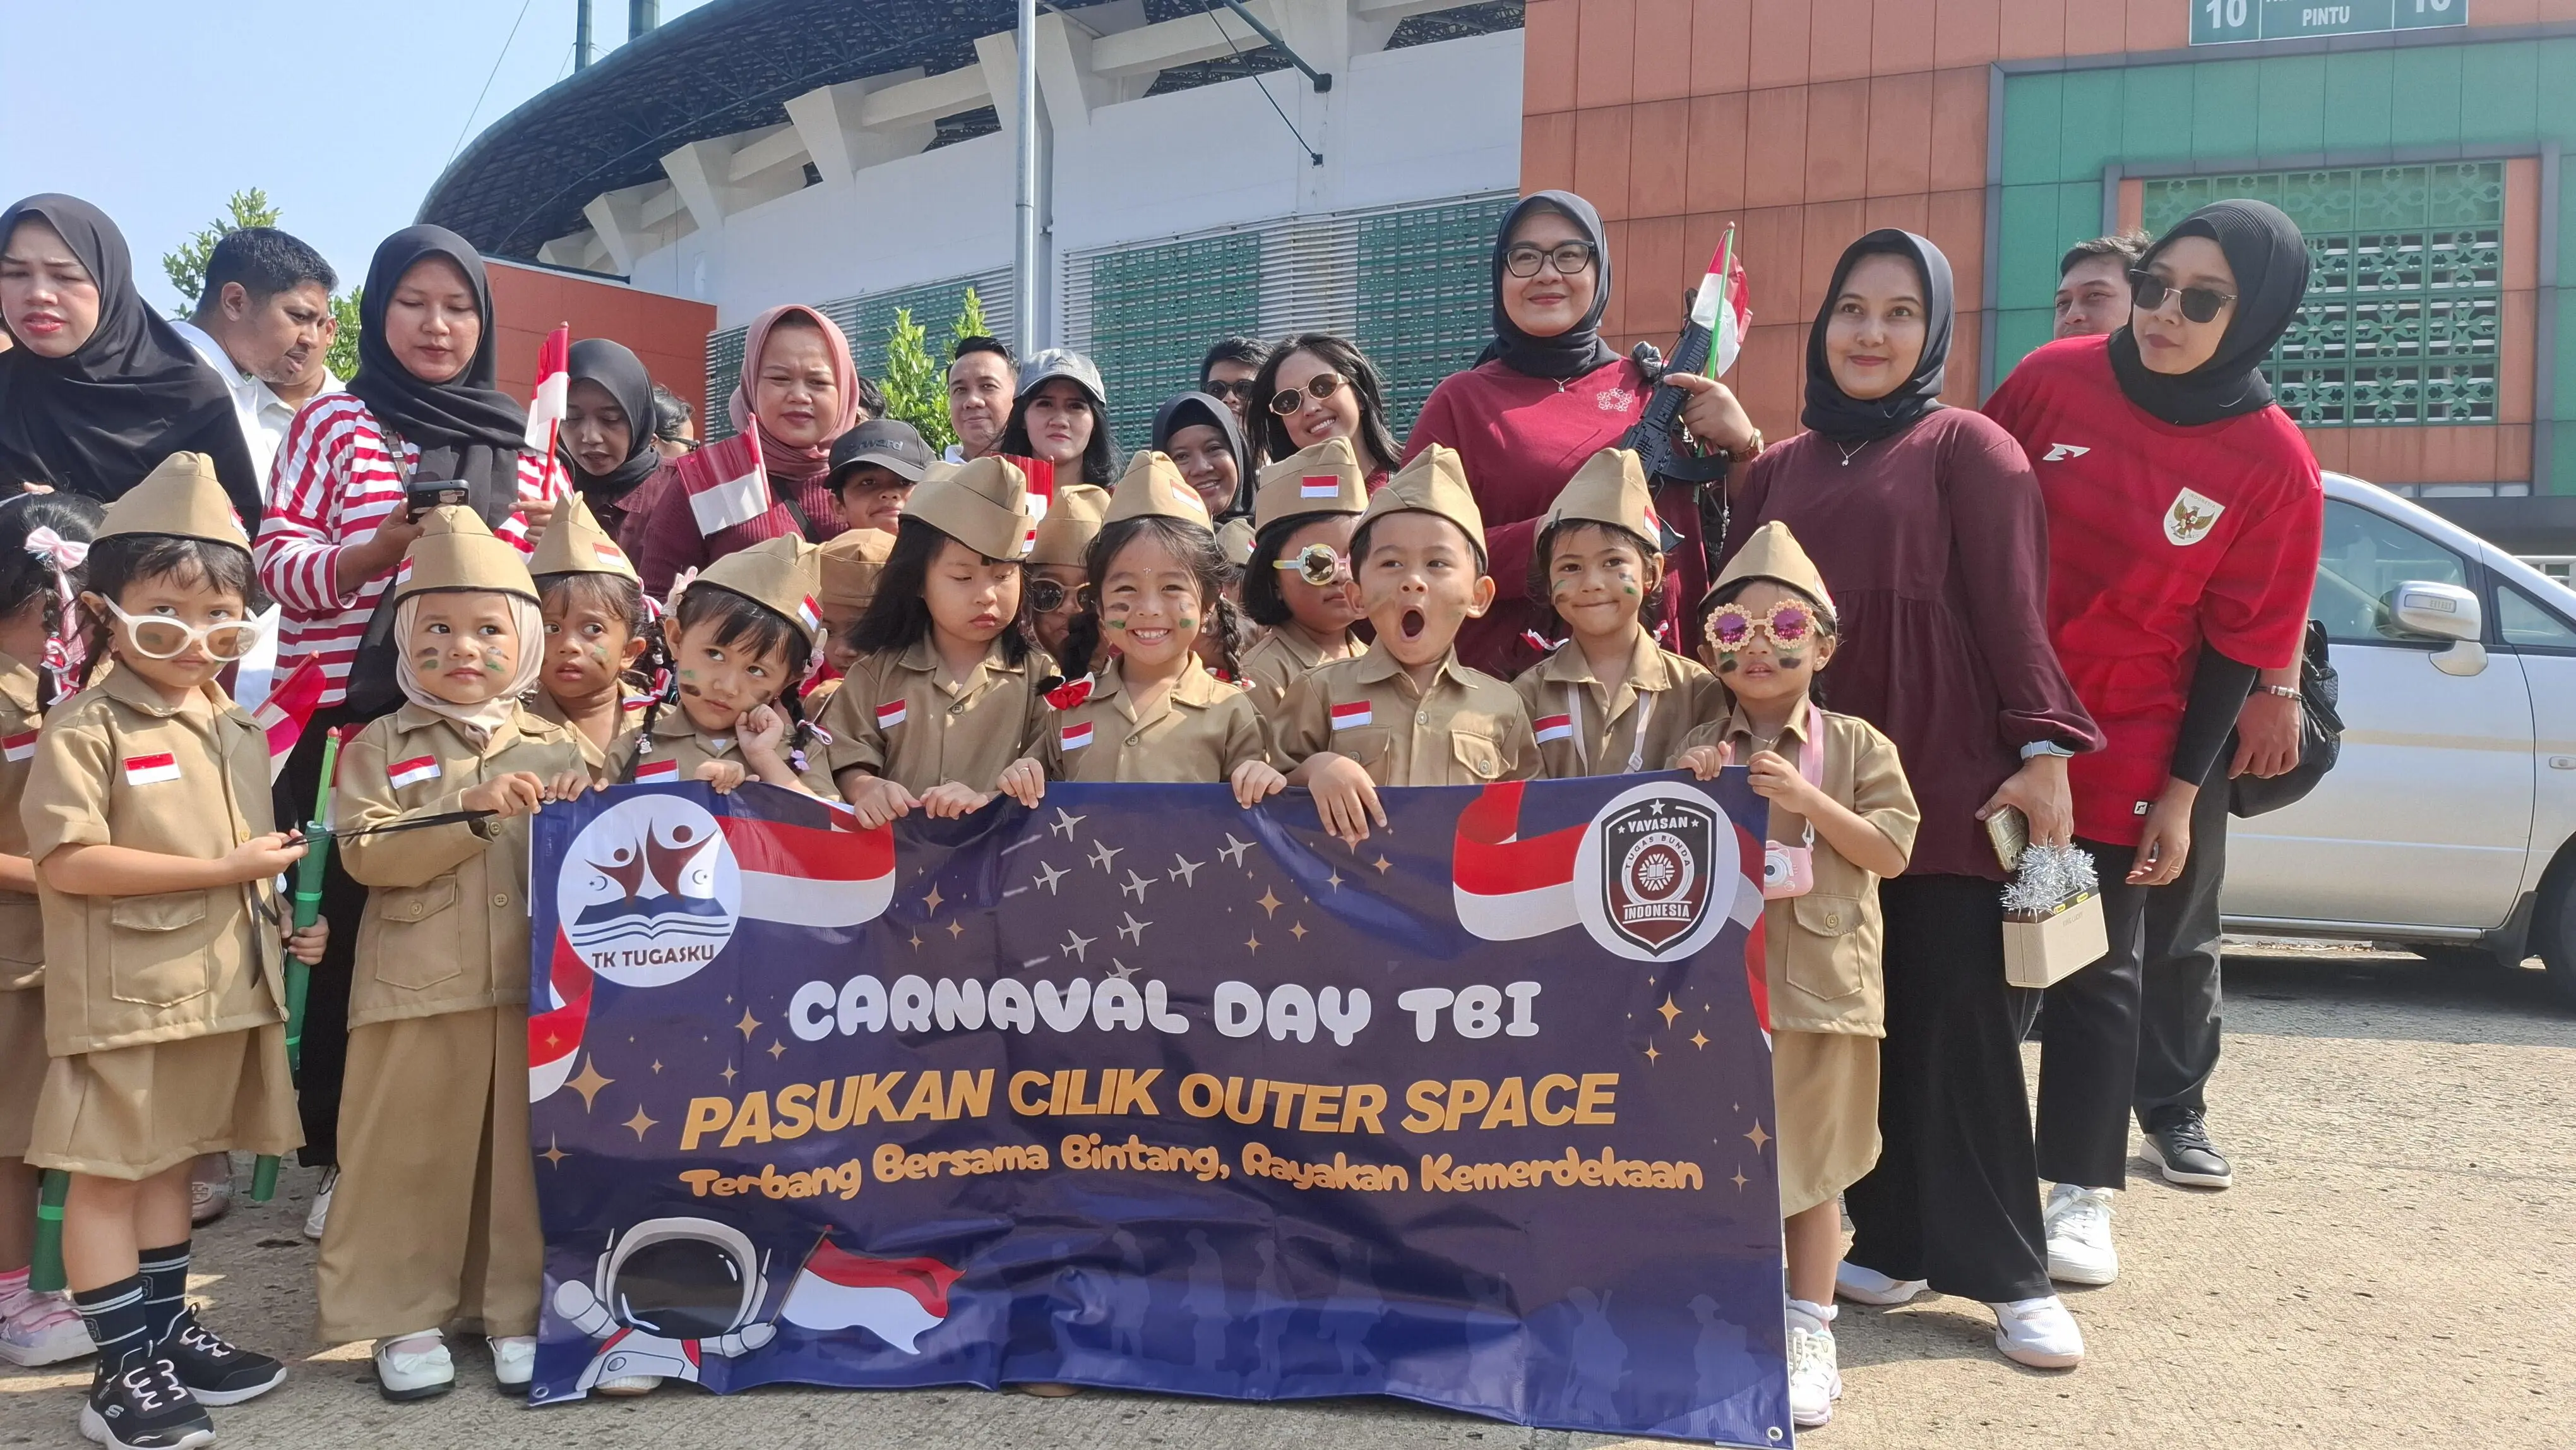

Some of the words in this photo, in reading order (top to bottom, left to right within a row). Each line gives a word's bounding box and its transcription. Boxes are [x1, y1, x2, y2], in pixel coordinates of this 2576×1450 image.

[2206, 0, 2247, 28] 10
[2302, 6, 2351, 27] PINTU
[1628, 816, 1688, 833] YAYASAN
[1625, 836, 1654, 870] TUGAS
[1661, 834, 1691, 866] BUNDA
[1625, 904, 1690, 920] INDONESIA
[592, 952, 616, 968] TK
[623, 944, 715, 966] TUGASKU
[789, 974, 1189, 1041] CARNAVAL
[1214, 981, 1371, 1046] DAY
[1398, 981, 1541, 1042] TBI
[680, 1069, 995, 1150] PASUKAN
[1008, 1069, 1164, 1116] CILIK
[1179, 1073, 1388, 1134] OUTER
[1401, 1073, 1619, 1133] SPACE
[679, 1158, 862, 1200] Terbang
[873, 1144, 1049, 1183] Bersama
[1061, 1133, 1229, 1181] Bintang,
[1242, 1142, 1409, 1191] Rayakan
[1421, 1146, 1703, 1192] Kemerdekaan
